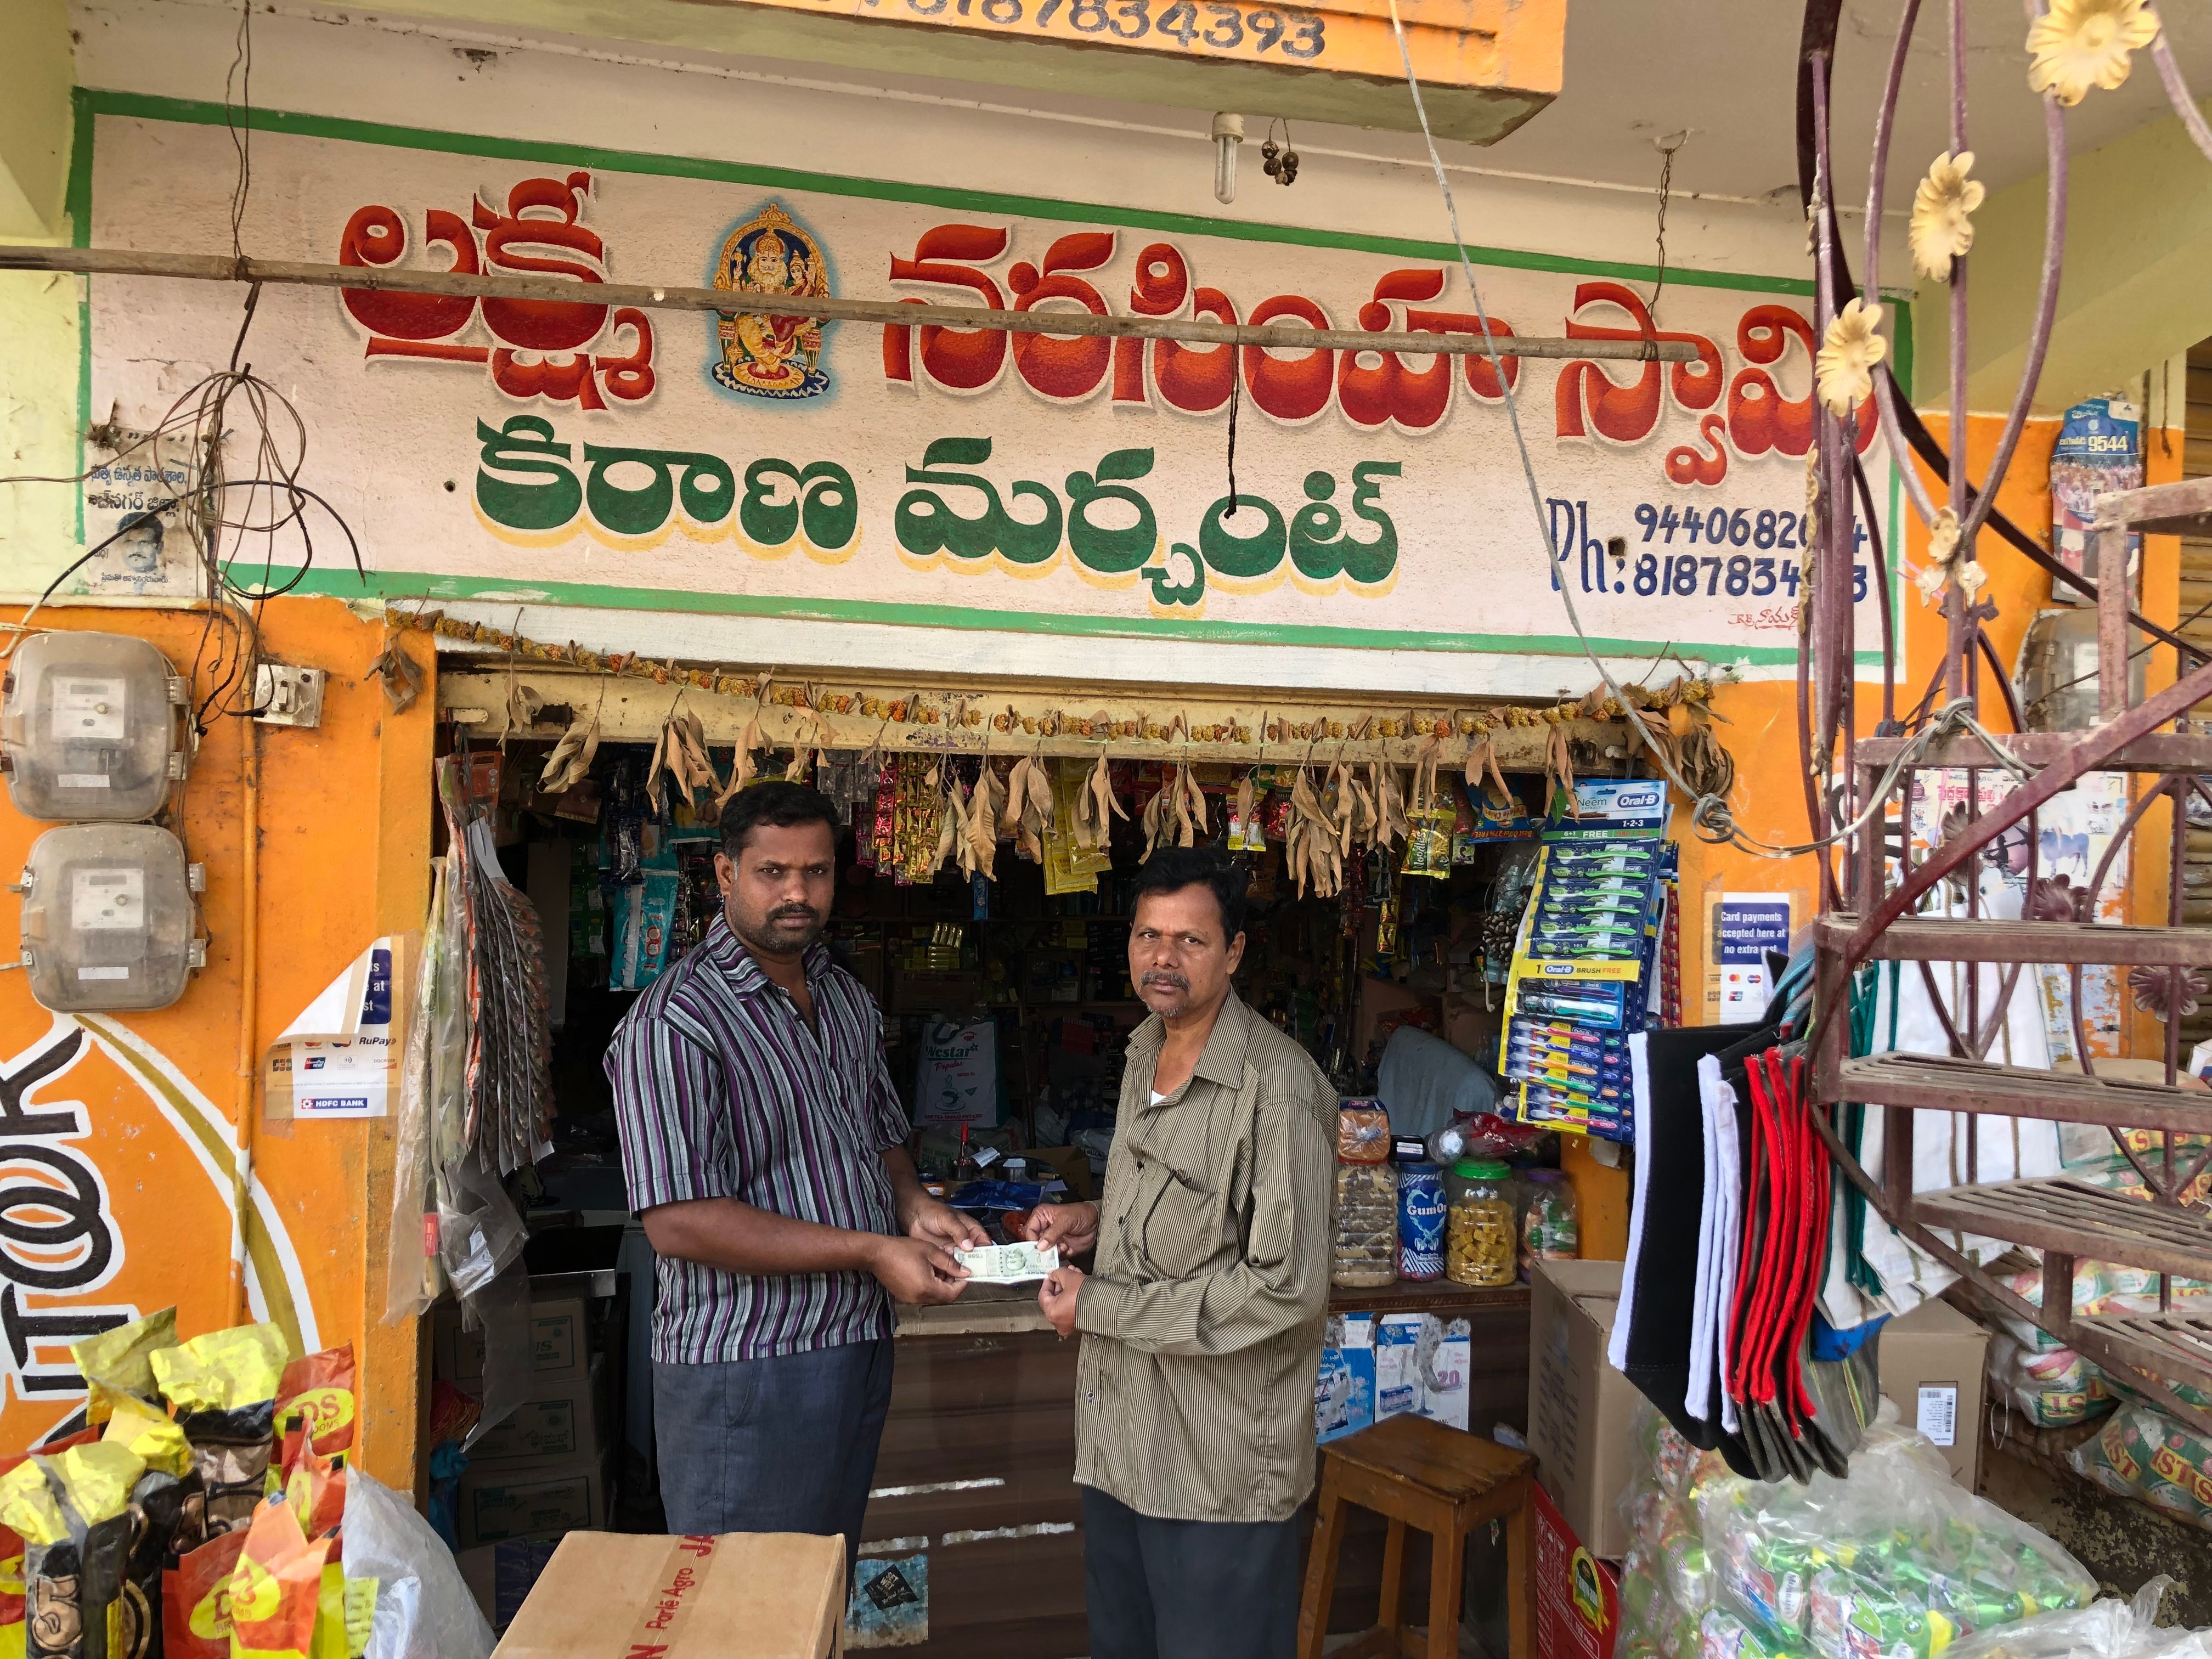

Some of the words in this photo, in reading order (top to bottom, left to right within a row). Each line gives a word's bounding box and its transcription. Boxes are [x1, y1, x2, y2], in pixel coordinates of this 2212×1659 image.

[883, 224, 1520, 429] నరసింహ
[2088, 435, 2128, 452] 9544
[476, 415, 857, 549] కిరాణ
[894, 436, 1402, 606] మర్చంట్
[1634, 503, 1868, 553] 94406824
[1633, 554, 1867, 603] 81878343
[1578, 798, 1607, 806] Neem
[1620, 795, 1656, 806] Oral-B
[1583, 830, 1608, 838] FREE
[1413, 831, 1426, 869] Noodles
[1720, 911, 1741, 922] Card
[1742, 911, 1782, 924] payments
[1717, 928, 1754, 940] accepted
[1756, 928, 1775, 938] here
[1776, 929, 1786, 938] at
[1724, 945, 1735, 954] no
[1737, 945, 1758, 954] extra
[1536, 964, 1541, 974] 1
[1545, 965, 1572, 973] Oral-B
[374, 980, 385, 991] at
[359, 1037, 391, 1047] RuPay
[926, 1046, 970, 1058] Westar
[662, 1567, 696, 1598] Agro
